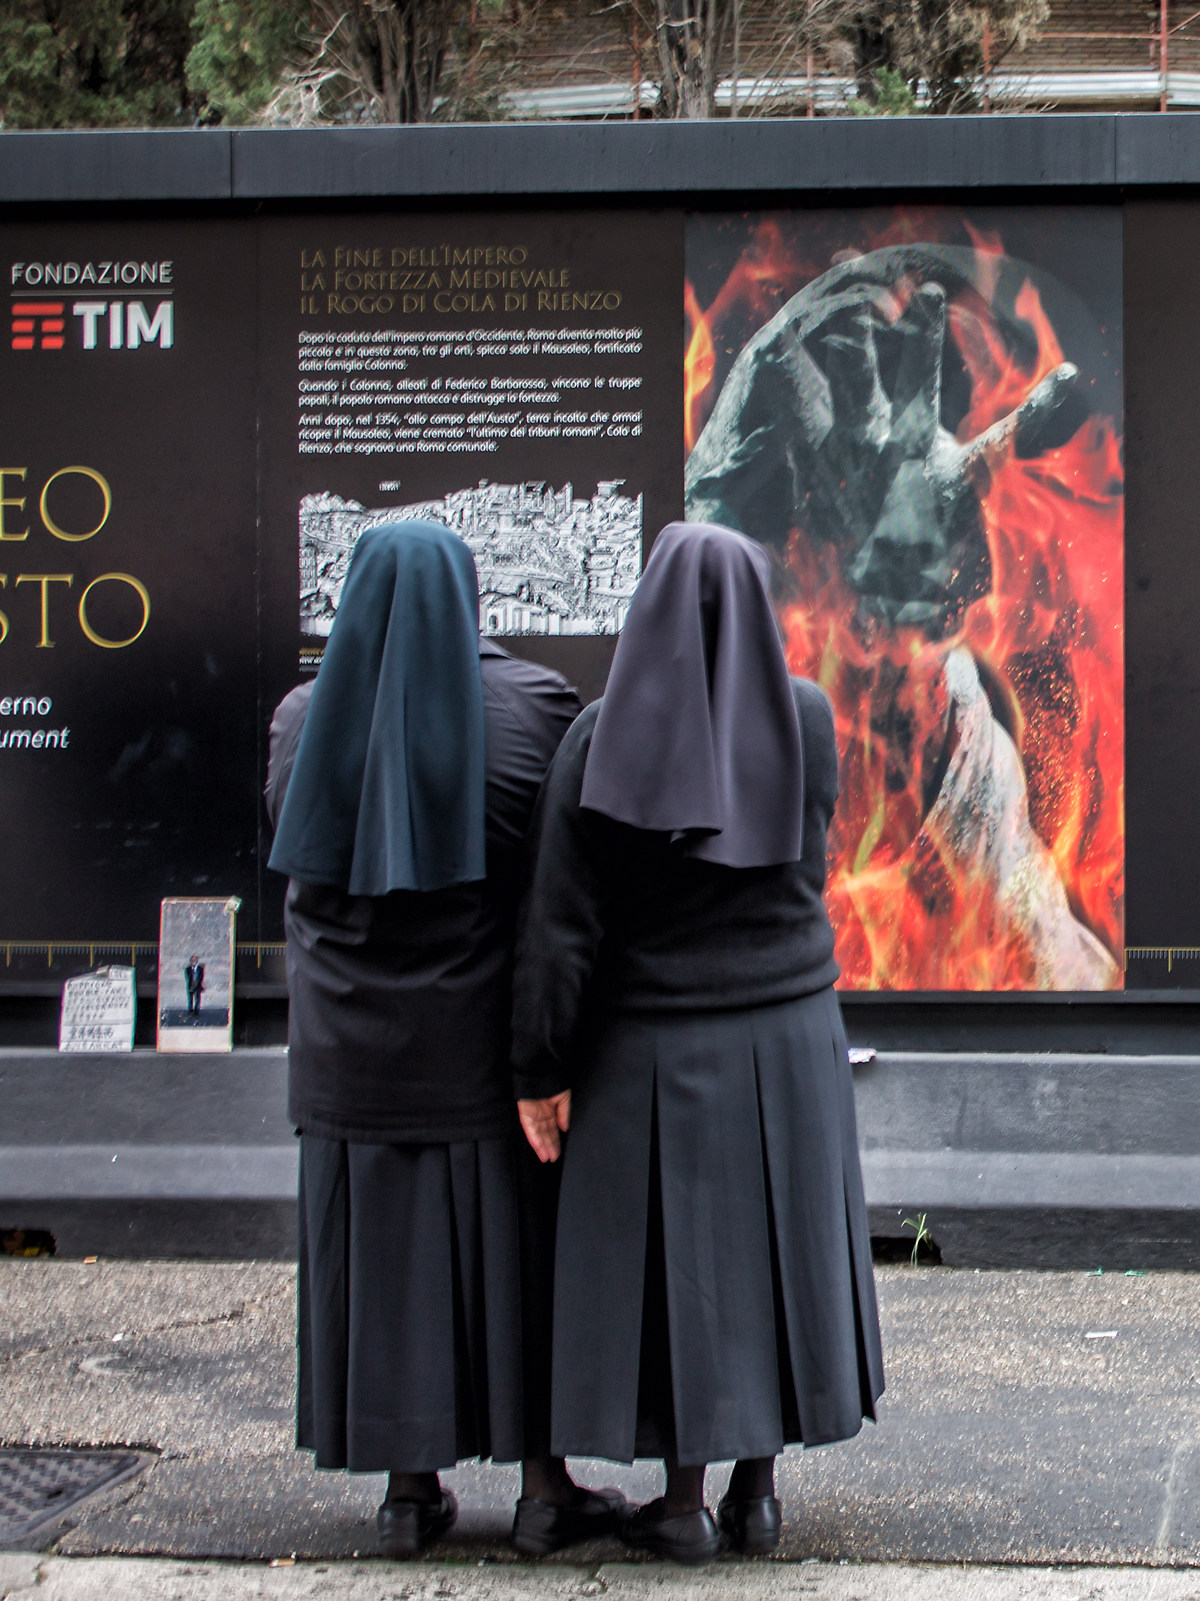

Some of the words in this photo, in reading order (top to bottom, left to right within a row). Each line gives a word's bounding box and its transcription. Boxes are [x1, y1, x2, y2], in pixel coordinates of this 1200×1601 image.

[301, 248, 325, 268] LA
[335, 245, 382, 267] FINE
[391, 244, 528, 266] DELL'IMPERO
[12, 261, 173, 284] FONDAZIONE
[301, 271, 325, 291] LA
[335, 268, 443, 291] FORTEZZA
[449, 267, 571, 289] MEDIEVALE
[301, 294, 320, 314] IL
[328, 291, 396, 314] ROGO
[403, 292, 426, 313] DI
[434, 289, 496, 313] COLA
[504, 291, 528, 312] DI
[537, 288, 622, 312] RIENZO
[73, 301, 174, 349] TIM
[0, 572, 150, 648] TO
[0, 697, 52, 715] erno
